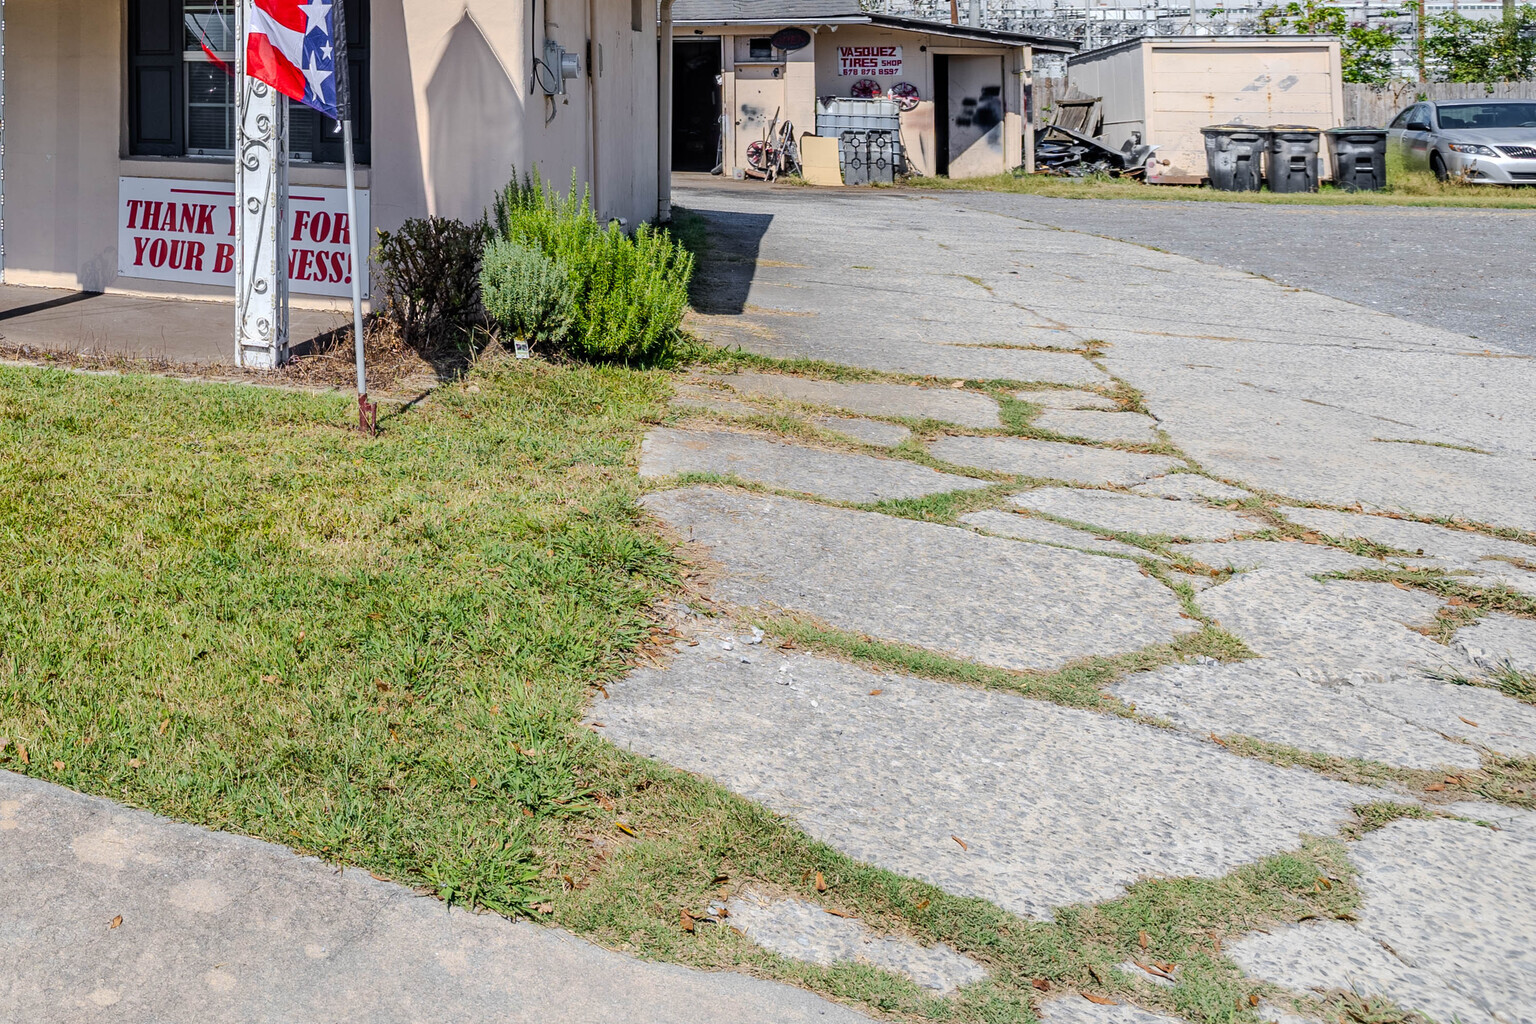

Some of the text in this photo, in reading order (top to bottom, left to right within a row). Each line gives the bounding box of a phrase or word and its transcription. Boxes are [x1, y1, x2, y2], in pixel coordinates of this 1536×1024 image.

[840, 46, 897, 57] VASQUEZ
[841, 58, 902, 68] TIRES SHOP
[126, 199, 216, 235] THANK
[291, 210, 351, 244] FOR
[133, 236, 205, 272] YOUR
